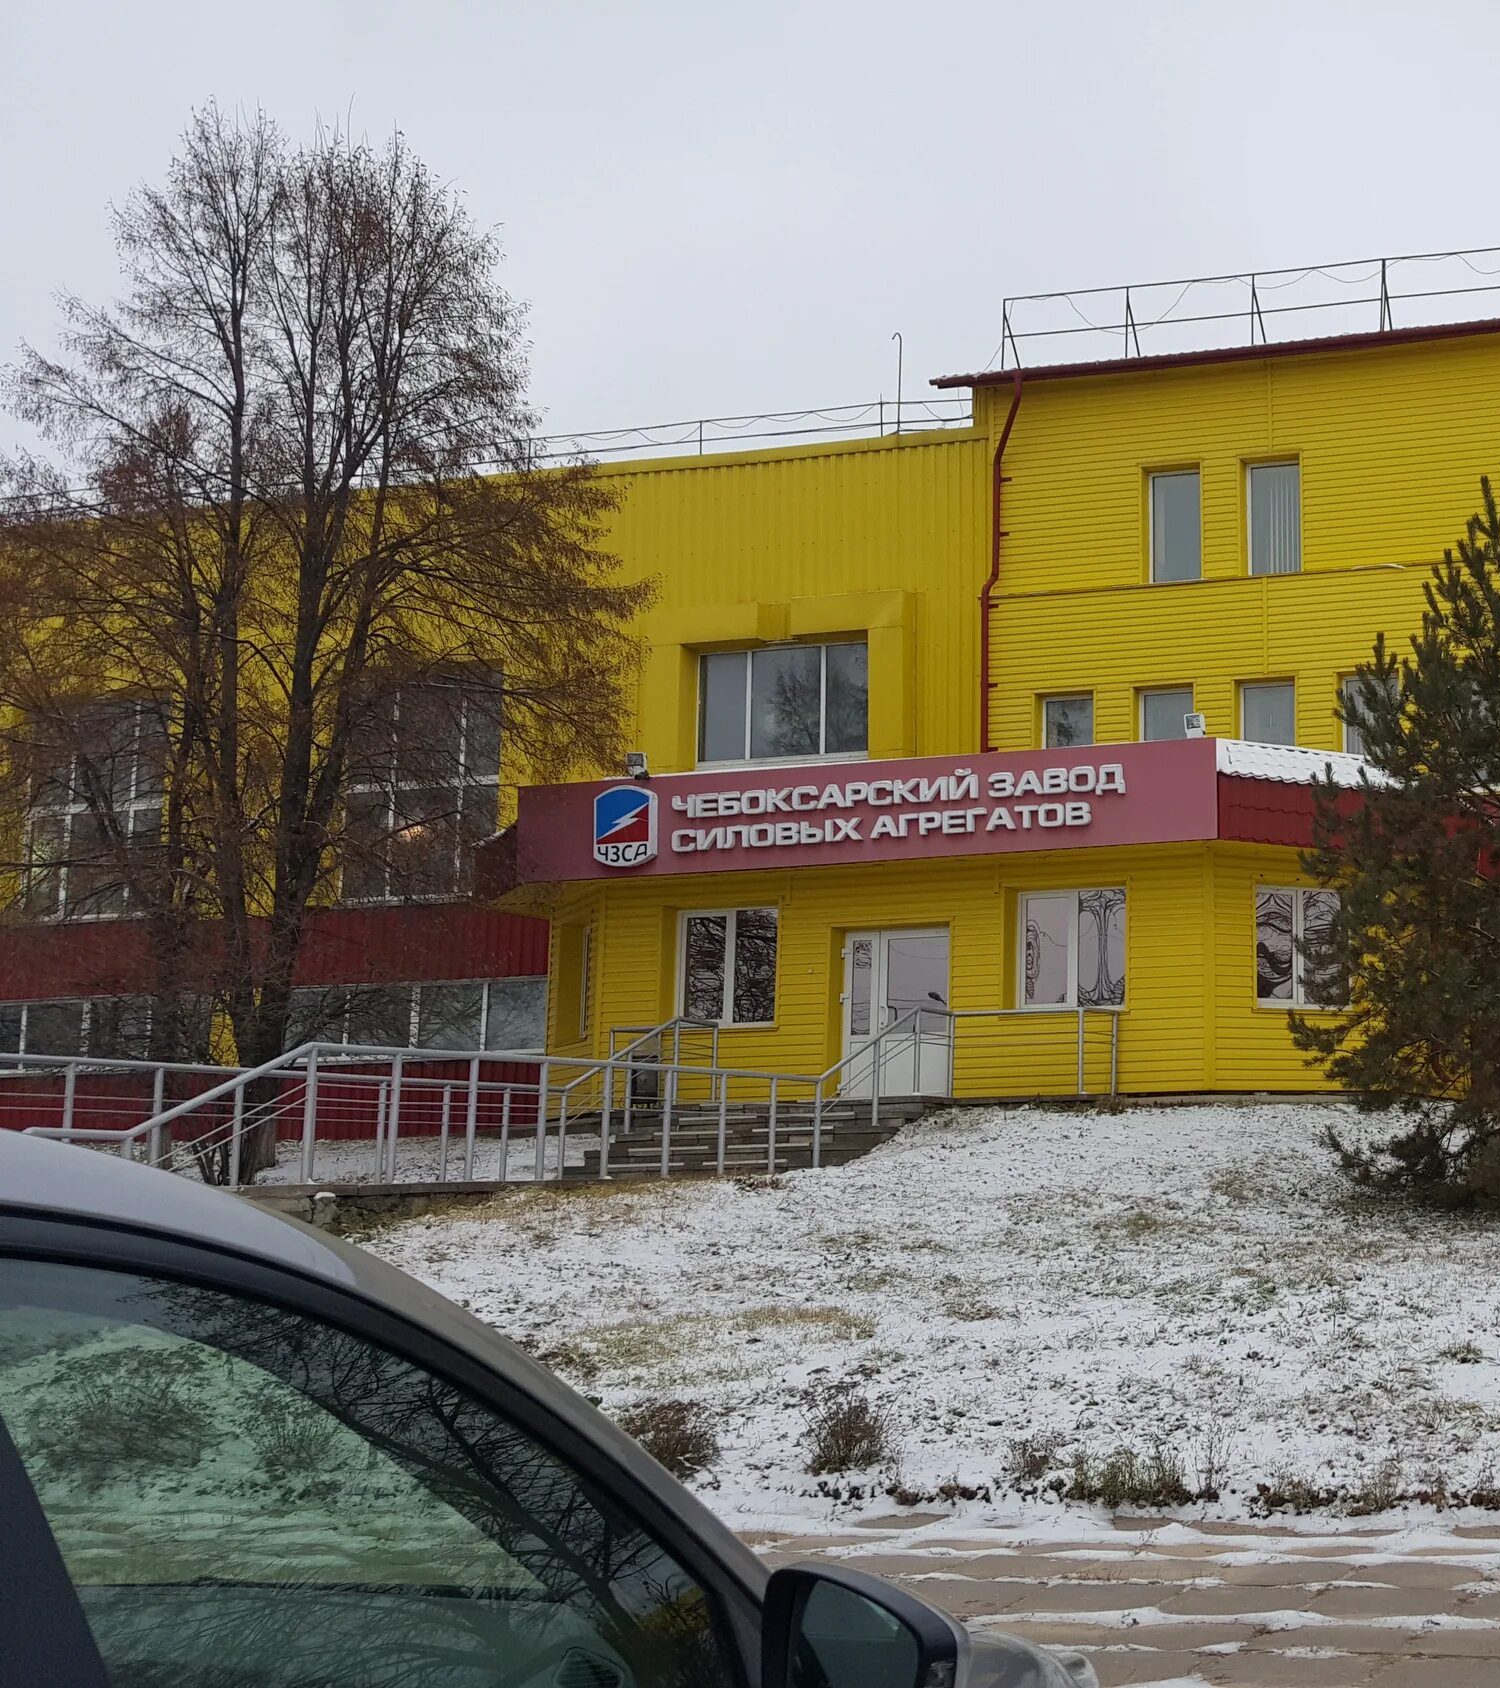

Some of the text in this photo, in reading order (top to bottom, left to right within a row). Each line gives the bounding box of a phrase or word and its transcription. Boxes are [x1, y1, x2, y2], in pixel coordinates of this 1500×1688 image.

[671, 763, 1126, 819] ЧЕБОКСАРСКИЙ ЗАВОД
[671, 801, 1092, 852] СИЛОВЫХ АГРЕГАТОВ
[597, 843, 648, 862] ЧЗСА
